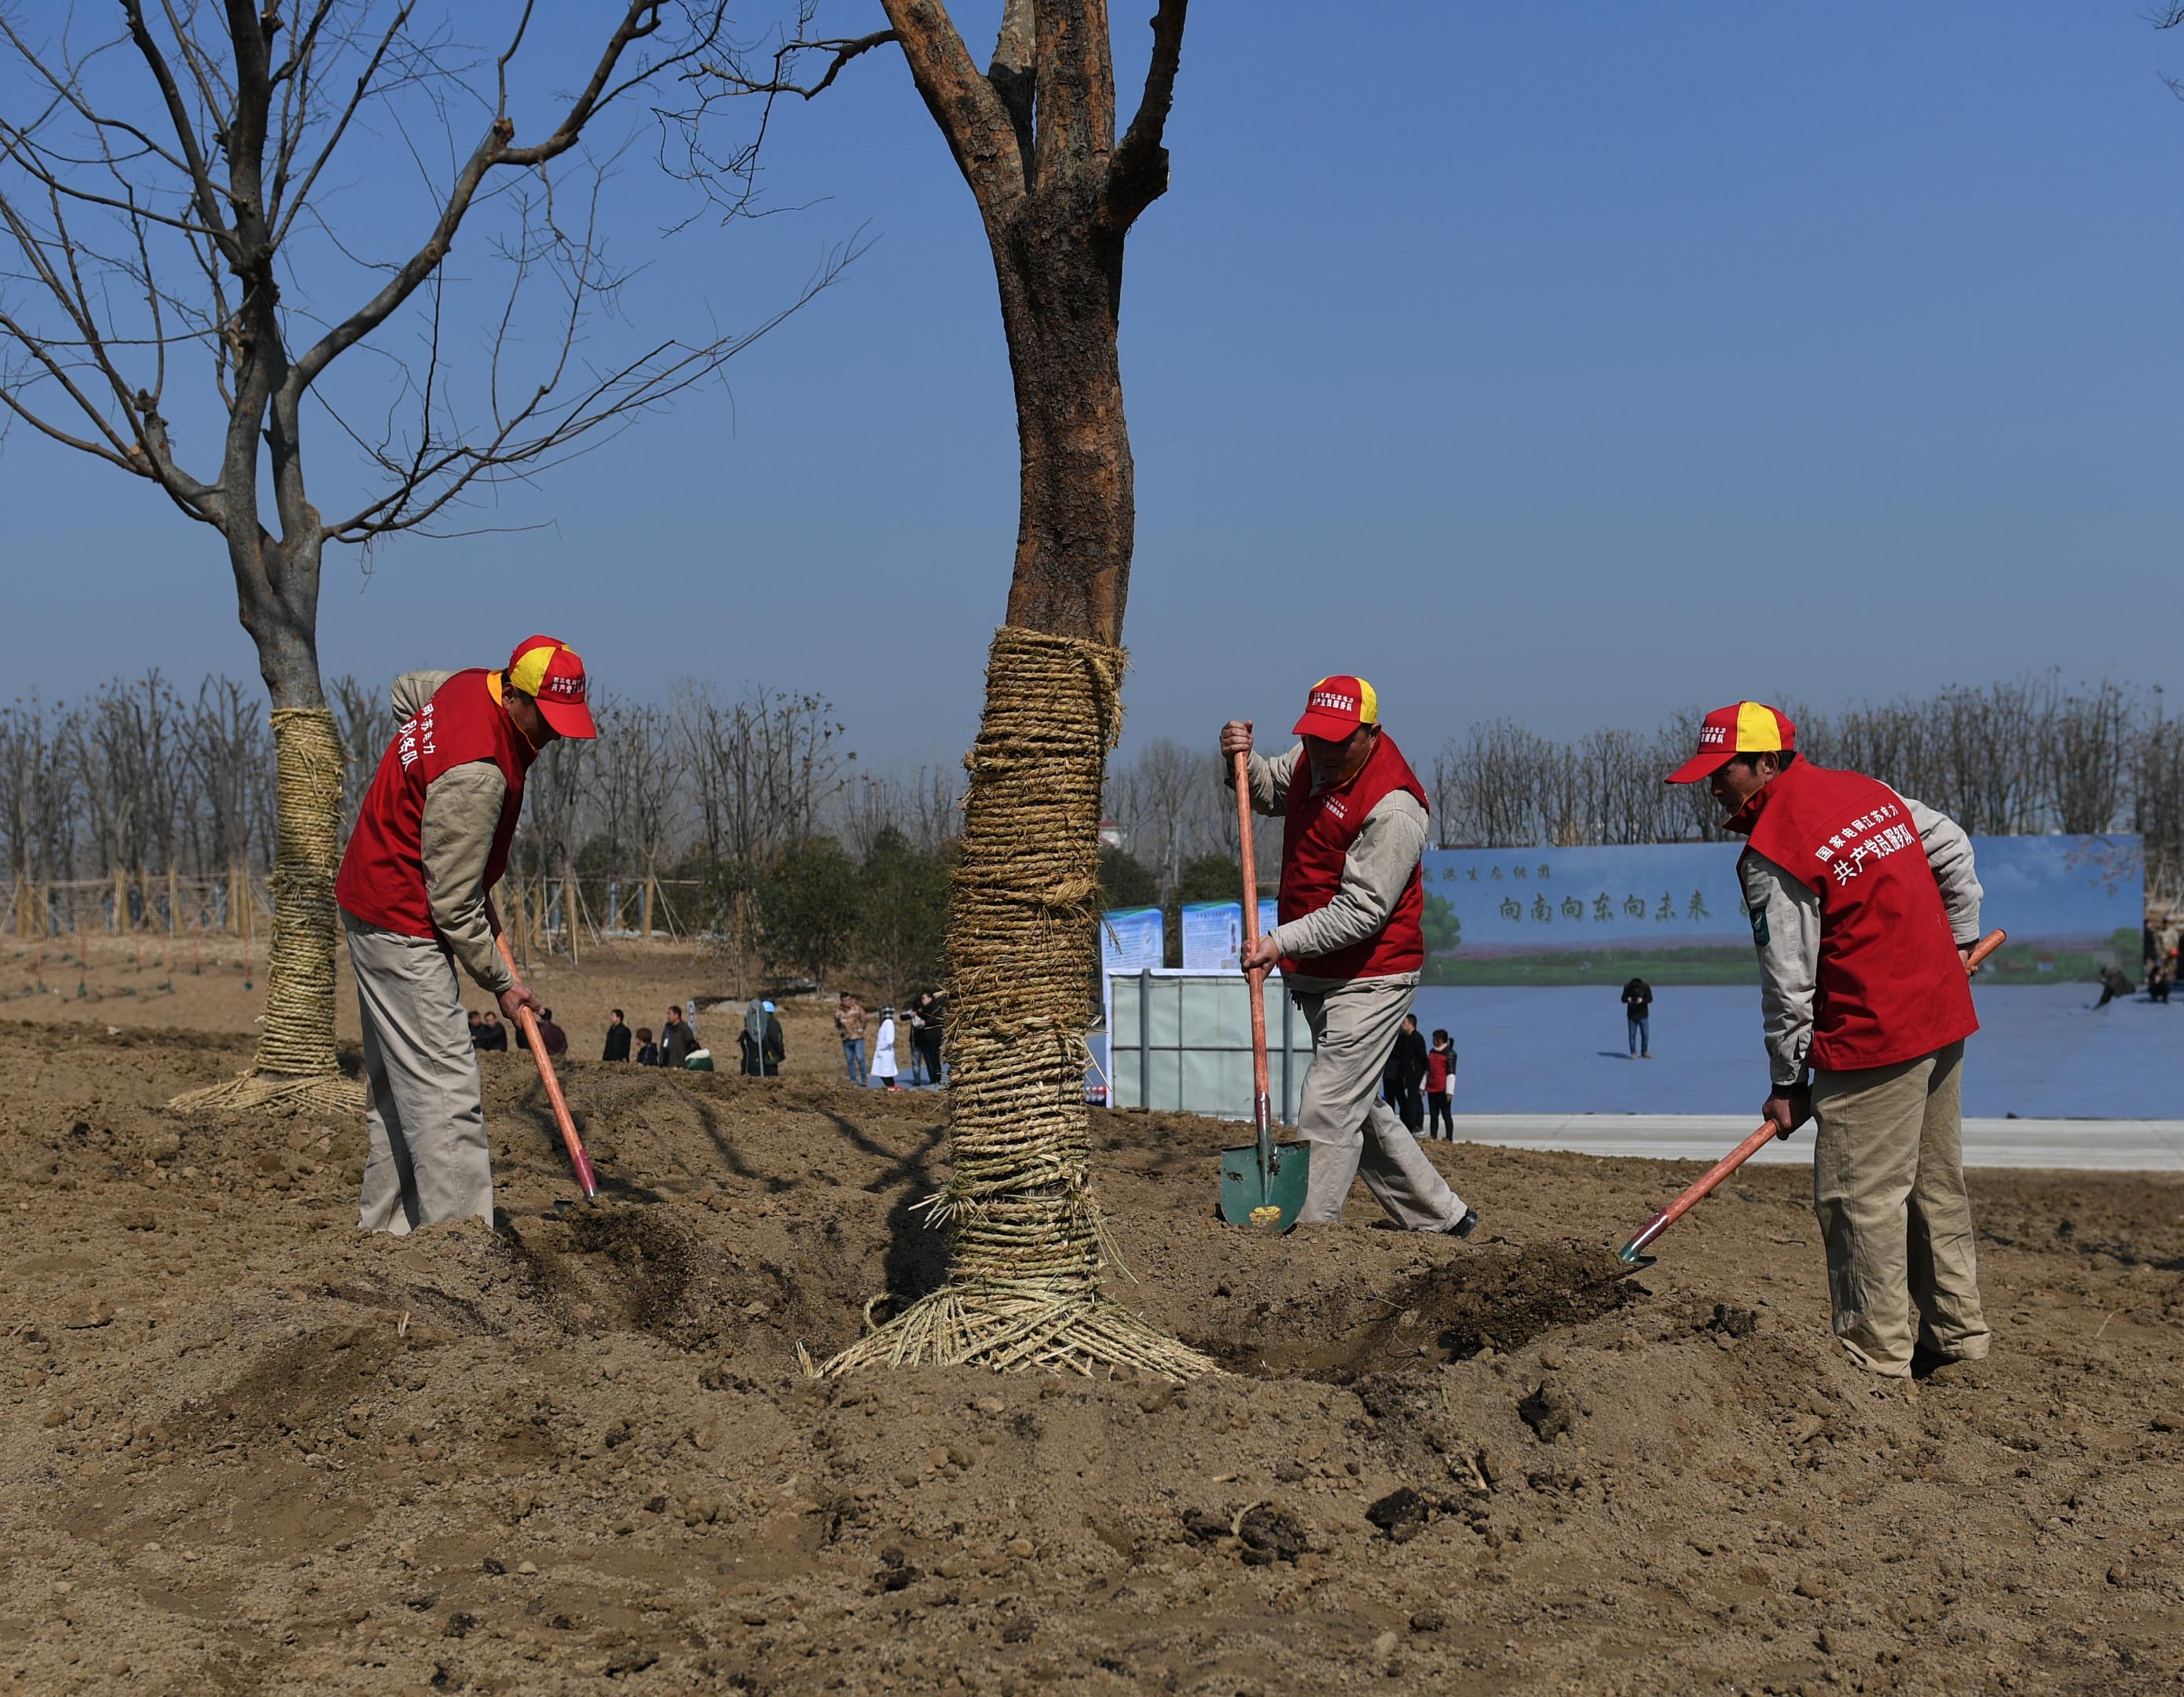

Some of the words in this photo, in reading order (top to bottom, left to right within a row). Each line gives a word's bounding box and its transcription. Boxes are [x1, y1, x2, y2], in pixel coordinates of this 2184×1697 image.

[1815, 802, 1899, 862] 国家电网江苏电力
[1833, 823, 1915, 886] 共产党员服务队
[1499, 889, 1711, 924] 向南向东向未来
